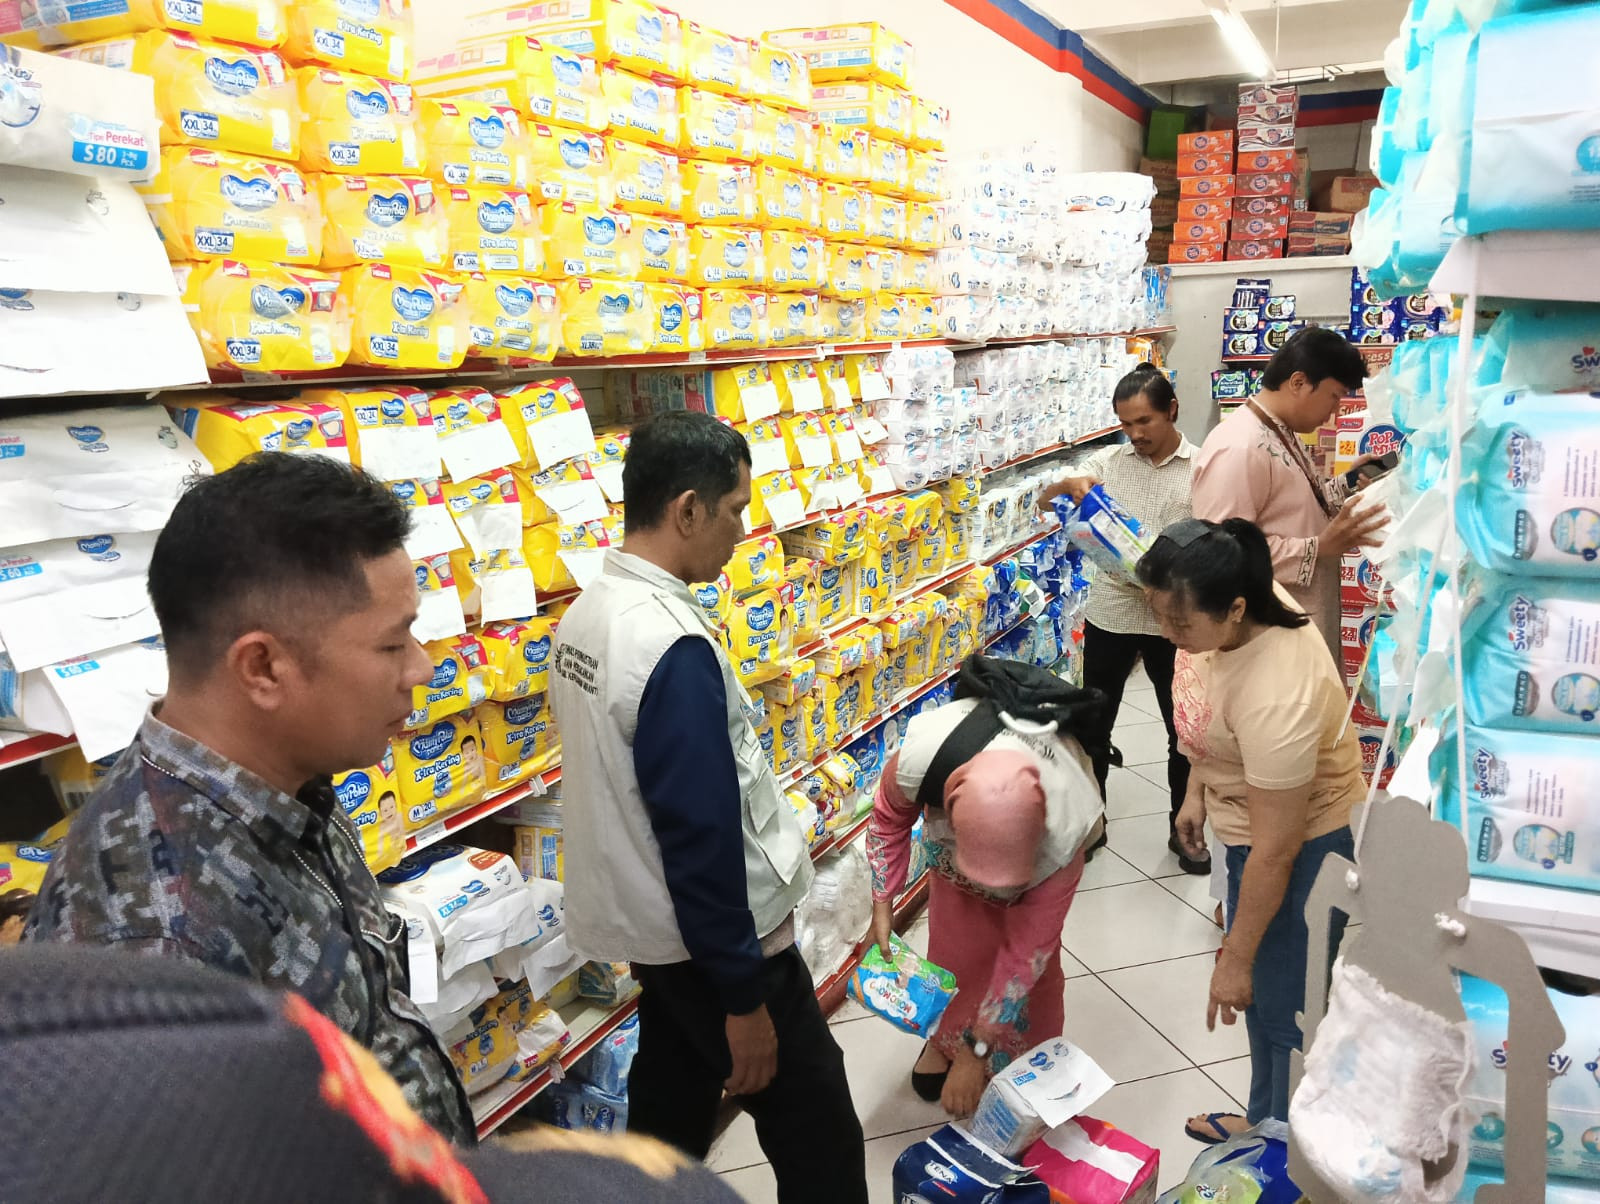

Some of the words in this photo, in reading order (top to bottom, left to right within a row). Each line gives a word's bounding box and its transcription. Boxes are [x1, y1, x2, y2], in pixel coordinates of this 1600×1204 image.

[187, 4, 198, 15] 34
[183, 118, 200, 131] XXL
[203, 120, 214, 131] 34
[106, 130, 144, 147] Perekat
[83, 144, 94, 162] S
[96, 146, 117, 165] 80
[347, 149, 356, 159] 34
[197, 235, 214, 247] XXL
[216, 236, 228, 247] 34
[229, 344, 244, 357] XXL
[246, 345, 257, 355] 34
[387, 341, 397, 352] 34
[1368, 431, 1393, 447] POP
[1512, 431, 1526, 489] Sweety
[8, 568, 22, 579] 60
[1515, 596, 1529, 651] Sweety
[440, 687, 464, 701] Kering
[524, 721, 547, 737] Kering
[414, 765, 436, 782] X-tra
[435, 754, 461, 773] Kering
[1478, 748, 1491, 799] Sweety
[338, 782, 369, 804] myPoko
[413, 809, 421, 817] M
[424, 801, 432, 812] 20
[929, 1161, 953, 1184] TENA
